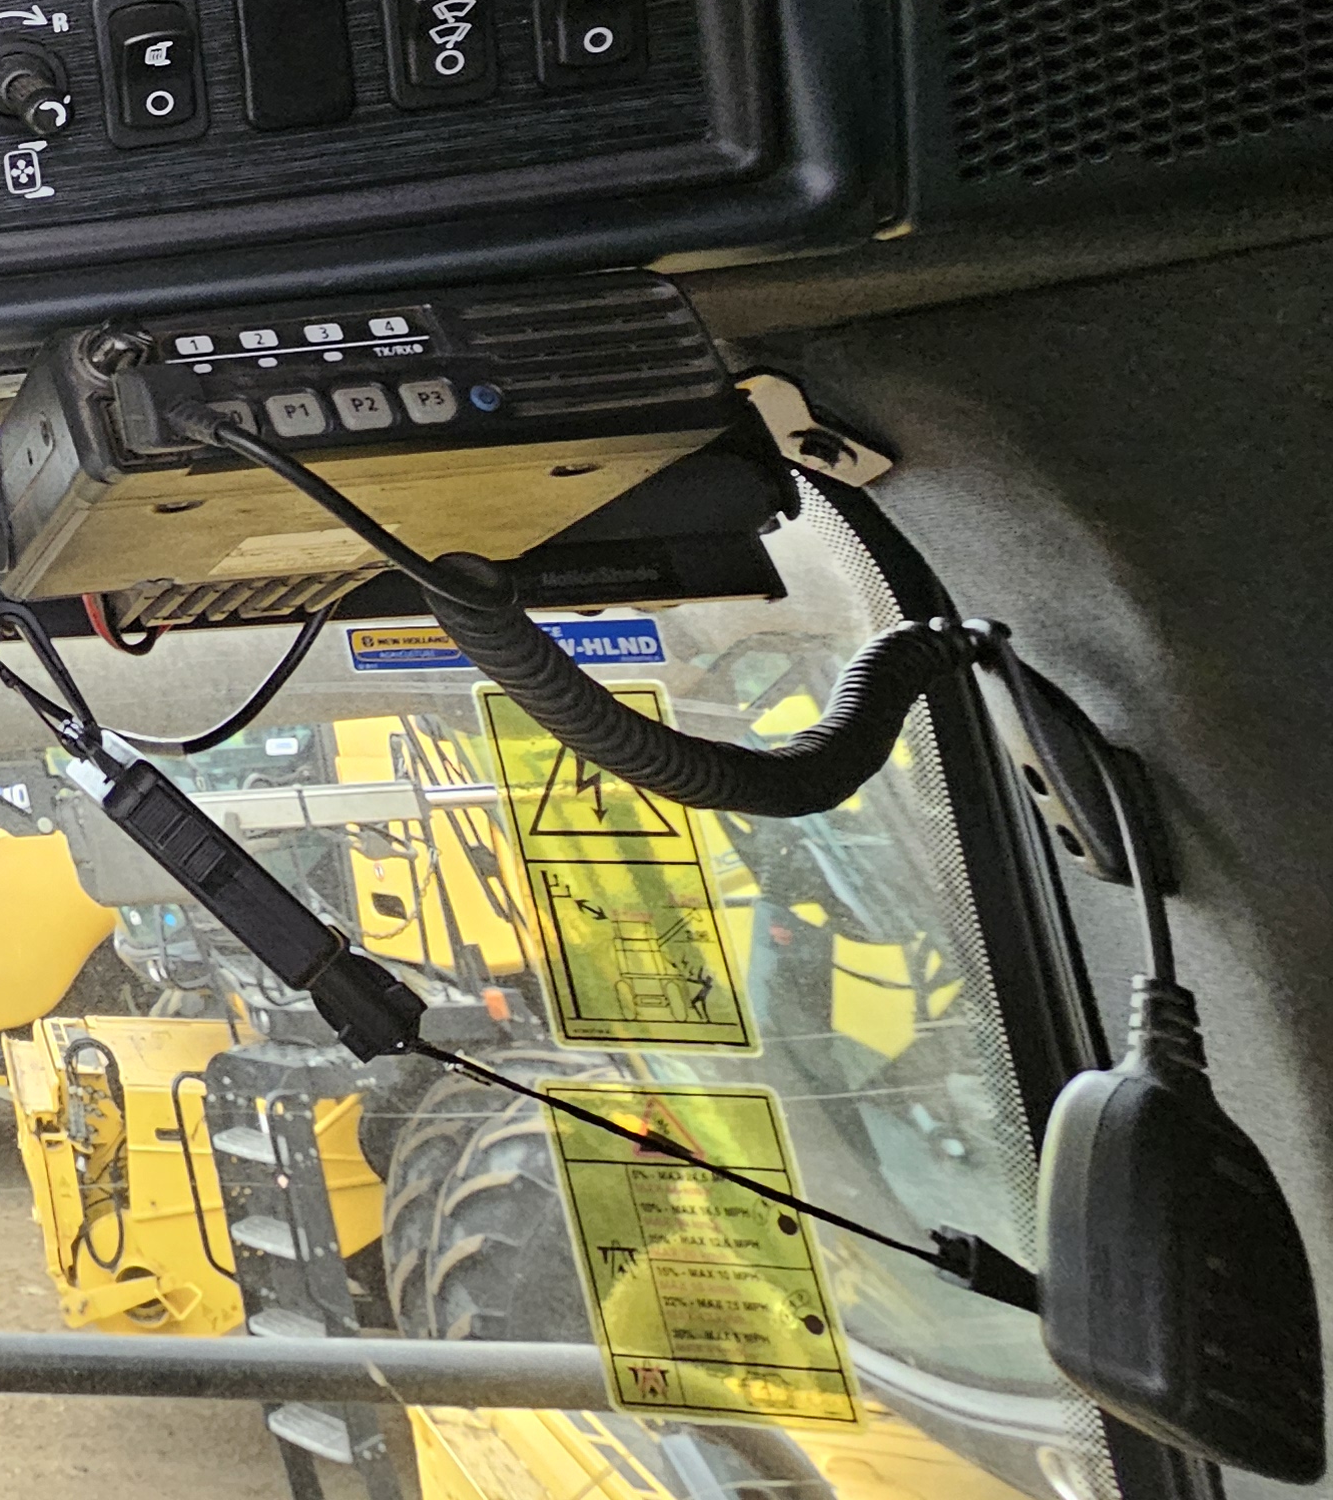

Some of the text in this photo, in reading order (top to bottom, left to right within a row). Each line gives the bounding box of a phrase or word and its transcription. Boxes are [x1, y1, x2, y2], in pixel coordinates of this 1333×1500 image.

[51, 12, 70, 33] R
[320, 327, 329, 340] 3
[384, 320, 395, 333] 4
[190, 339, 199, 351] 1
[254, 333, 265, 345] 2
[373, 344, 414, 359] TX/RX
[351, 396, 380, 413] P2
[418, 389, 446, 406] P3
[284, 403, 311, 419] P1
